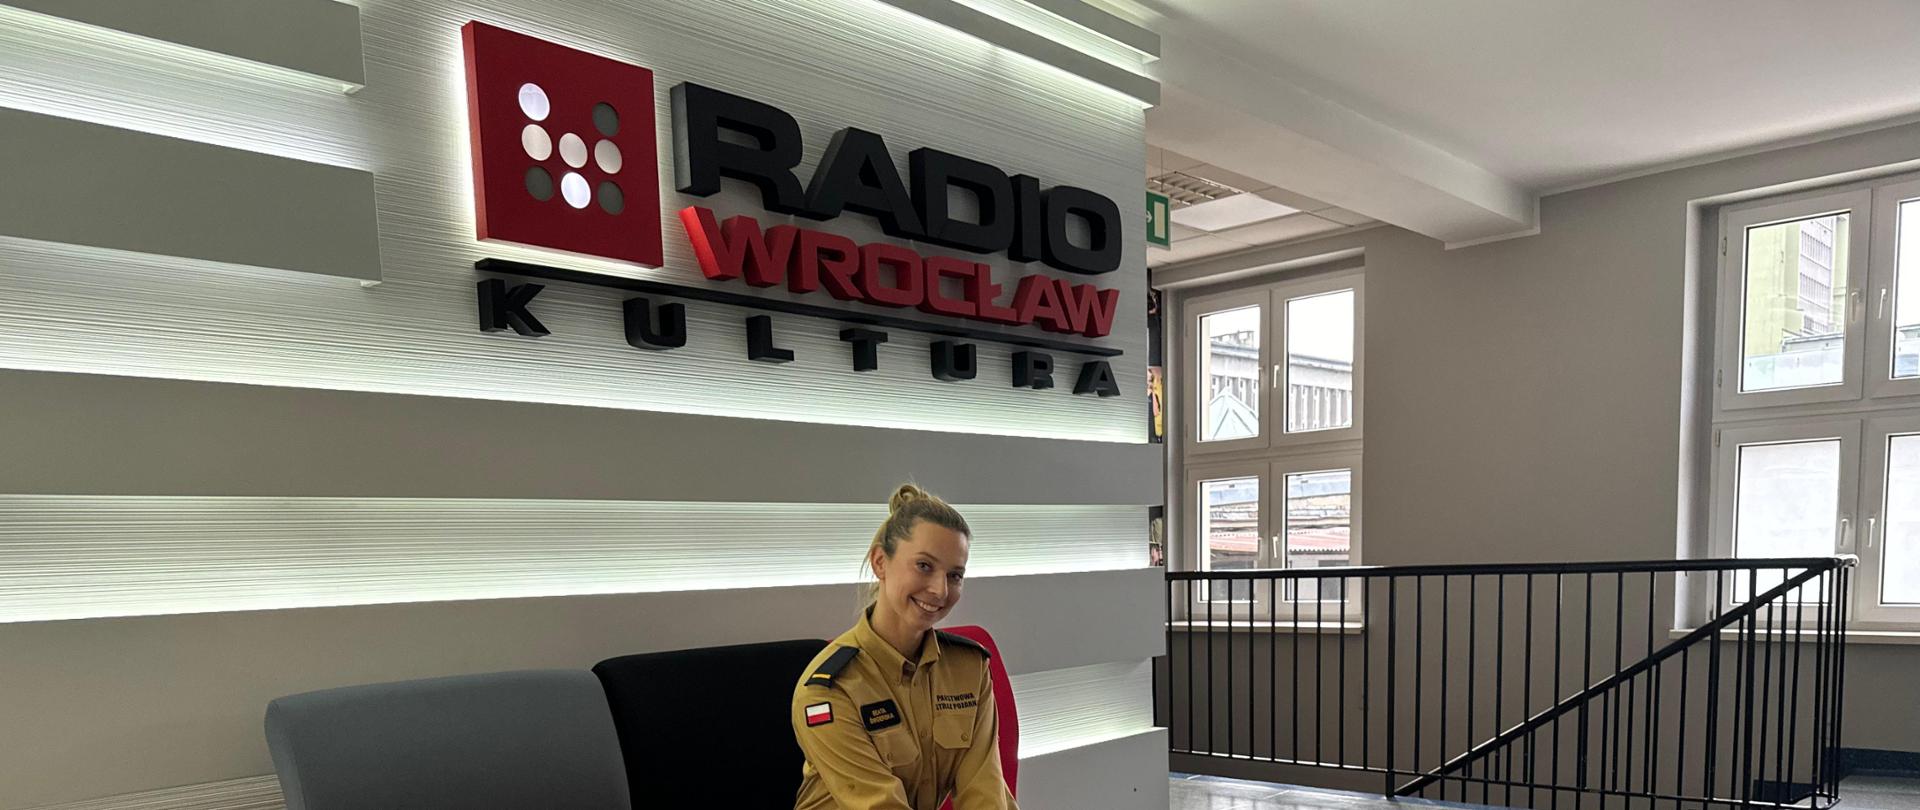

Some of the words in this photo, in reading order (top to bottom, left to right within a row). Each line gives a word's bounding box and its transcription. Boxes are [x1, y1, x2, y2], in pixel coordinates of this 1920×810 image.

[670, 81, 1121, 274] RADIO
[477, 278, 1121, 397] KULTURA
[679, 206, 1120, 338] WROCŁAW
